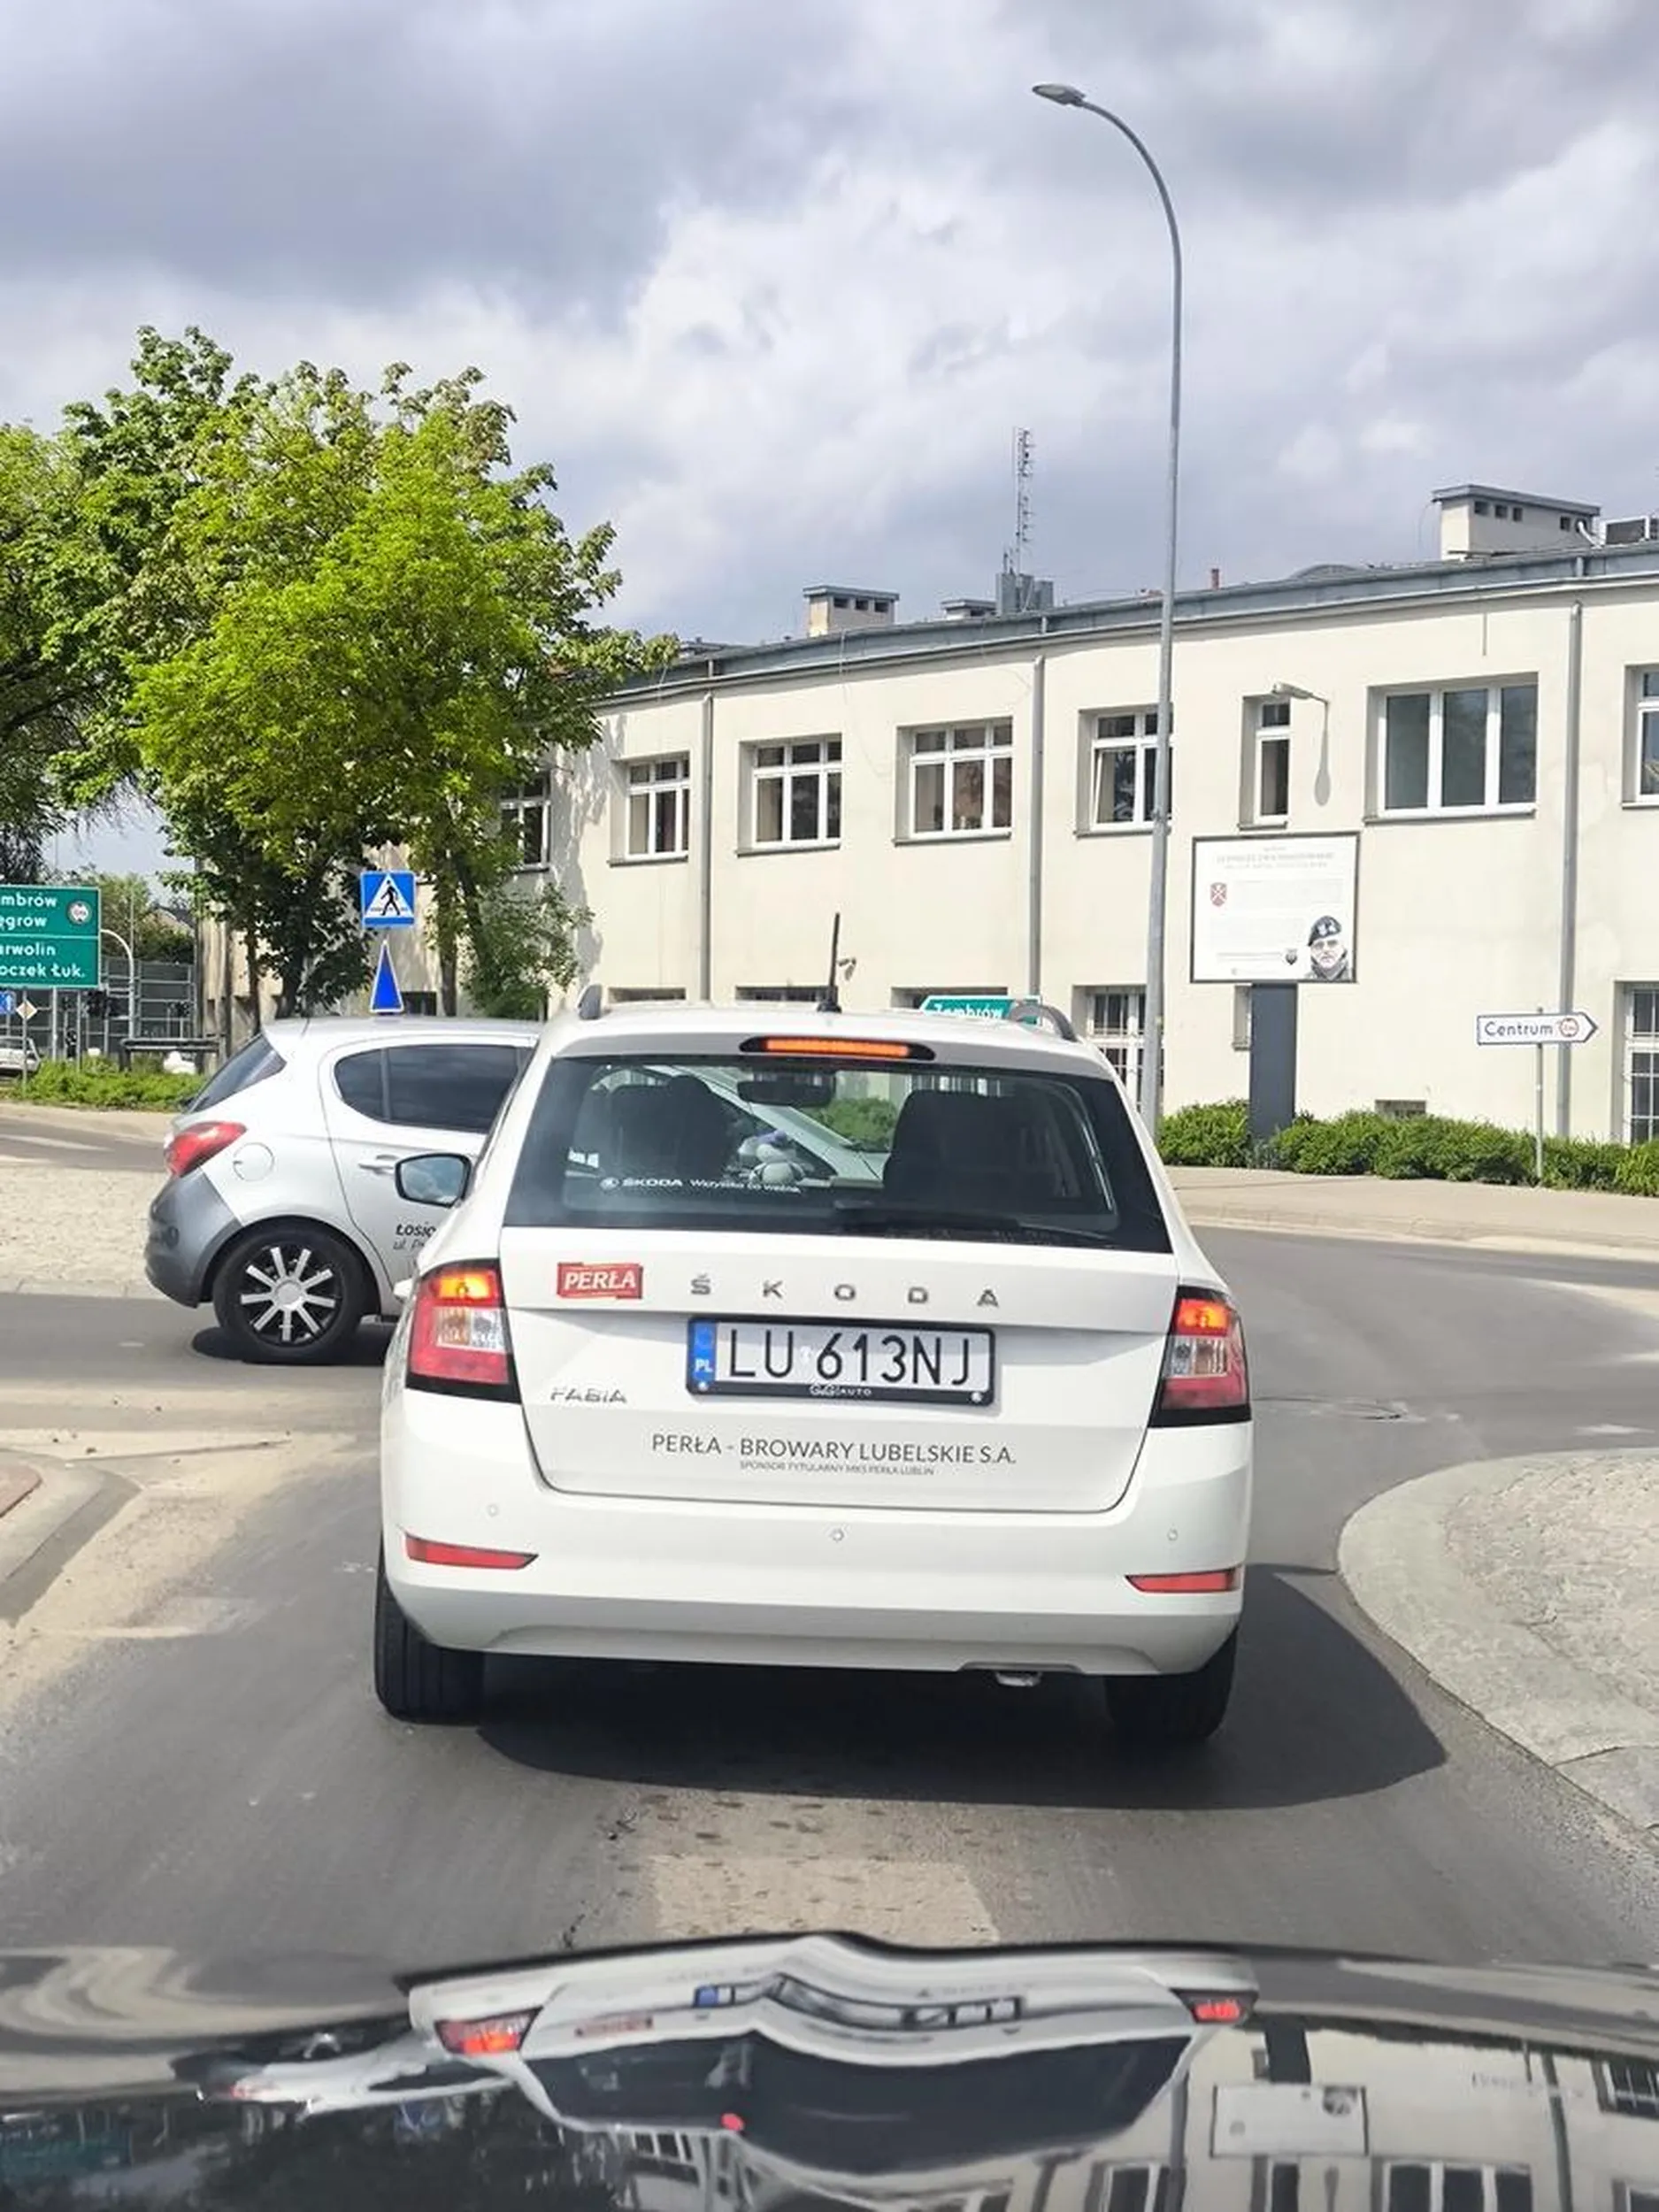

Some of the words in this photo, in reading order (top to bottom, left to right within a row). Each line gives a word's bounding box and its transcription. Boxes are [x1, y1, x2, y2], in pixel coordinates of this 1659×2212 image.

[1485, 1021, 1553, 1036] Centrum
[564, 1271, 636, 1290] PERŁA
[729, 1328, 795, 1379] LU
[816, 1332, 970, 1386] 613NJ
[652, 1433, 722, 1455] PERŁA
[740, 1438, 854, 1460] BROWARY
[859, 1443, 974, 1463] LUBELSKIE
[979, 1445, 1017, 1464] S.A.
